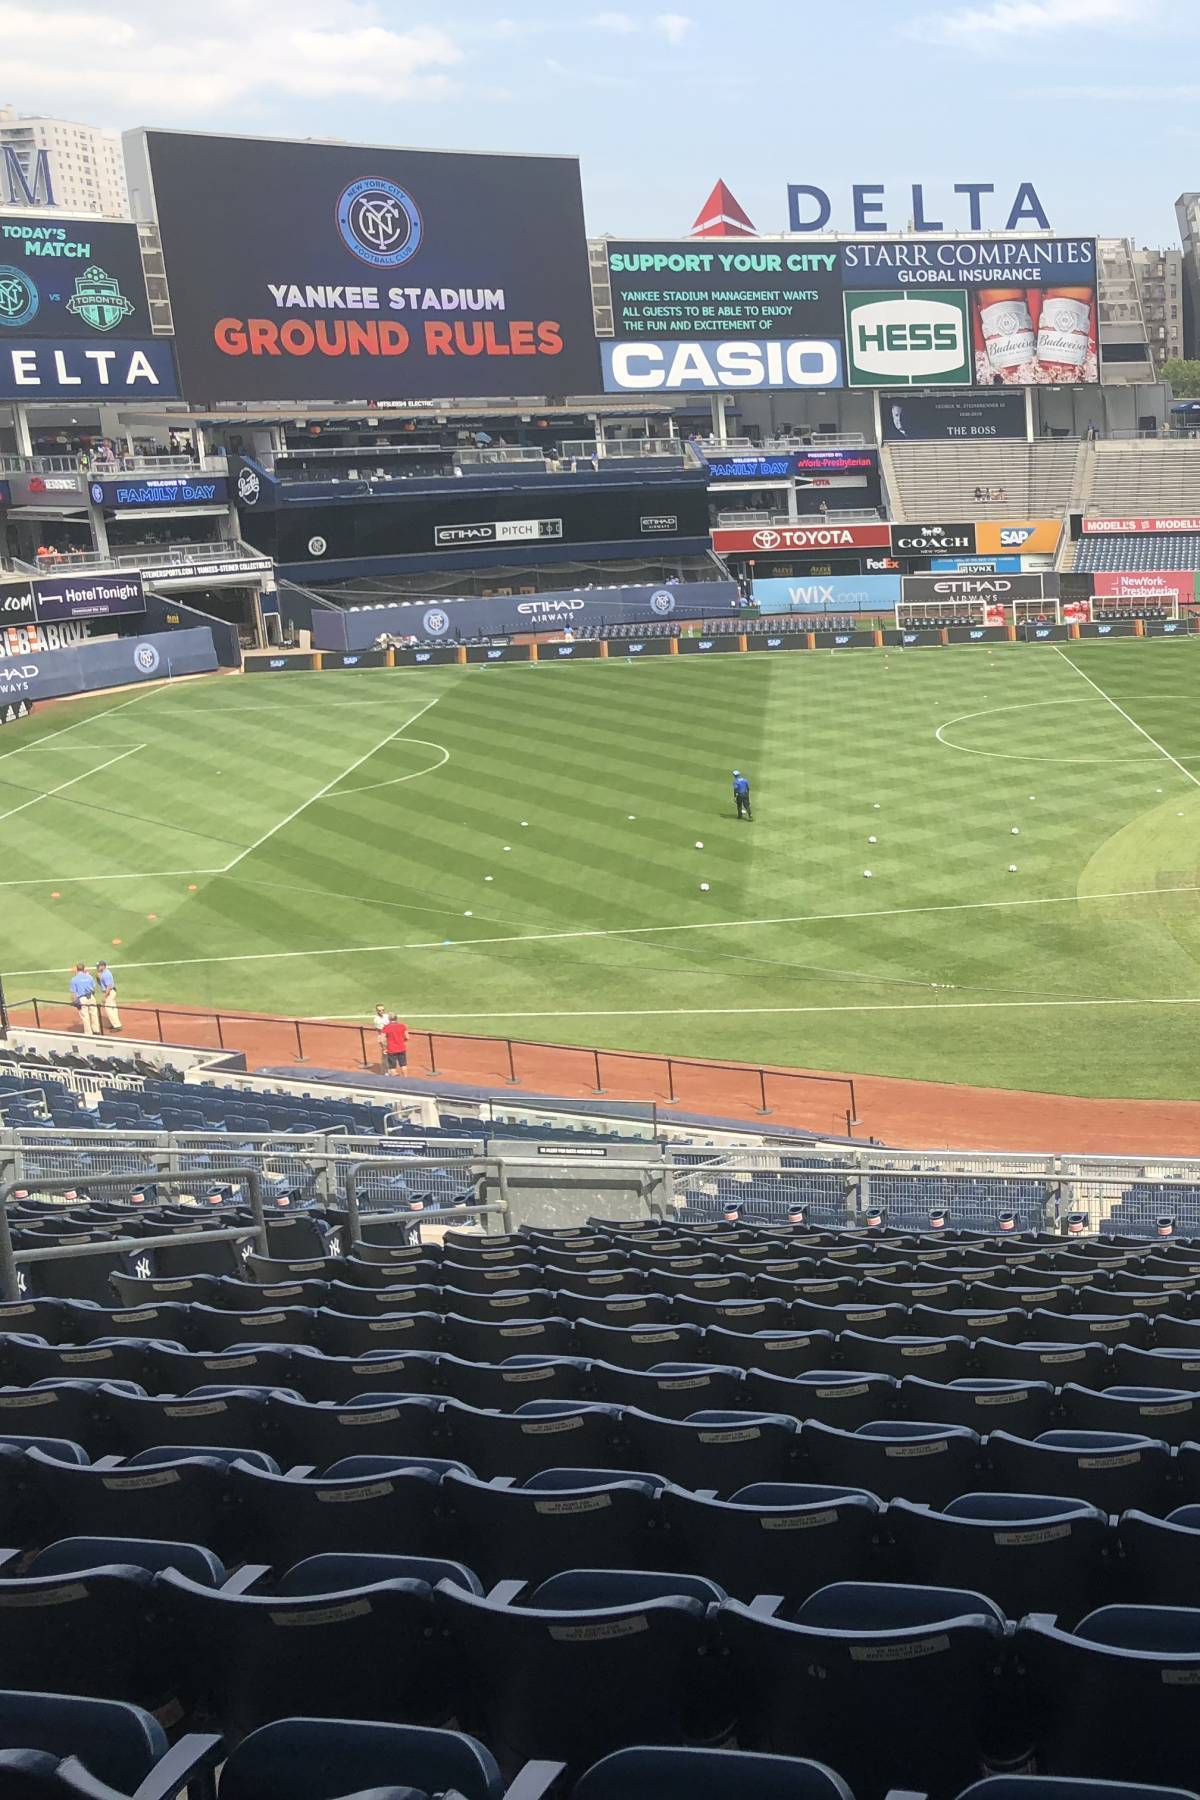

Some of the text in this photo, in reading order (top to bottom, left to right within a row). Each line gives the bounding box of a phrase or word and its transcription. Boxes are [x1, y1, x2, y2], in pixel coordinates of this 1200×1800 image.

[347, 180, 406, 199] NEW YORK CITY
[786, 182, 1050, 232] DELTA
[2, 225, 66, 241] TODAY'S
[25, 241, 91, 258] MATCH
[354, 244, 413, 265] FOOTBALL CLUB
[845, 242, 1092, 267] STARR COMPANIES
[610, 253, 837, 272] SUPPORT YOUR CITY
[897, 268, 1041, 282] GLOBAL INSURANCE
[75, 295, 124, 306] TORONTO
[267, 283, 506, 311] YANKEE STADIUM
[621, 290, 819, 302] YANKEE STADIUM MANAGEMENT WANTS
[623, 305, 793, 317] ALL GUESTS TO BE ABLE TO ENJOY
[624, 319, 774, 331] THE FUN AND EXCITEMENT OF
[213, 317, 564, 358] GROUND RULES
[858, 323, 957, 352] HESS
[611, 341, 838, 388] CASIO
[947, 426, 996, 435] THE BOSS
[710, 464, 757, 476] FAMILY
[760, 463, 788, 475] DAY
[116, 485, 216, 503] FAMILY DAY
[439, 525, 533, 540] ETIHAD PITCH
[1088, 521, 1136, 530] MODELL'S
[783, 530, 853, 545] TOYOTA
[898, 537, 969, 548] COACH
[1001, 531, 1028, 544] SAP
[867, 558, 899, 569] FedEx
[934, 581, 1011, 592] ETIHAD
[1121, 577, 1166, 586] NewYork-
[949, 594, 998, 602] AIRWAYS
[517, 599, 584, 614] ETIHAD
[531, 612, 574, 623] AIRWAYS
